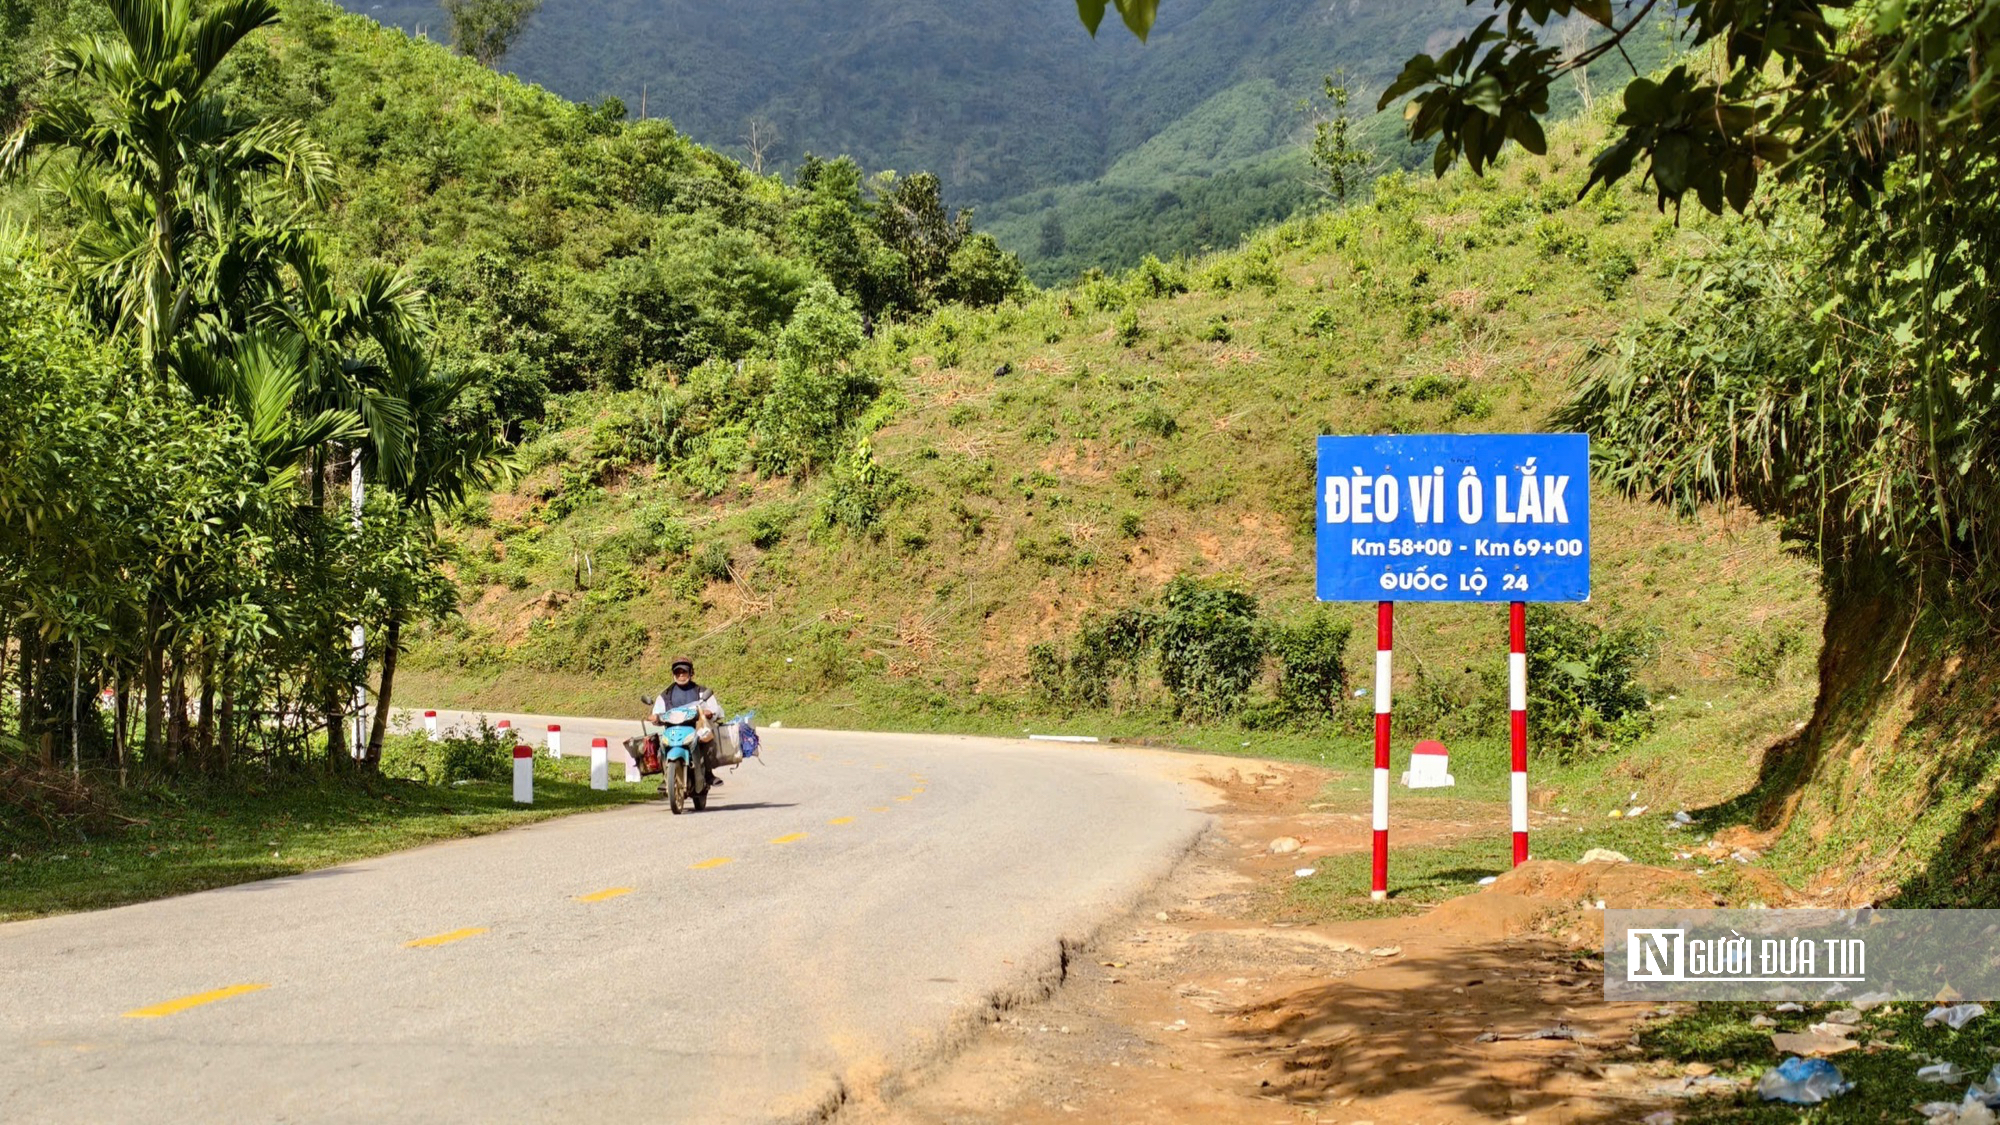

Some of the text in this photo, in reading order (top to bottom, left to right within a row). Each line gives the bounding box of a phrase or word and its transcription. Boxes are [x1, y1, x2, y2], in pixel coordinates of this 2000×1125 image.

[1325, 466, 1399, 524] ĐÈO
[1457, 466, 1483, 524] Ô
[1495, 457, 1570, 524] LẮK
[1380, 564, 1529, 596] QUỐC LỘ 24
